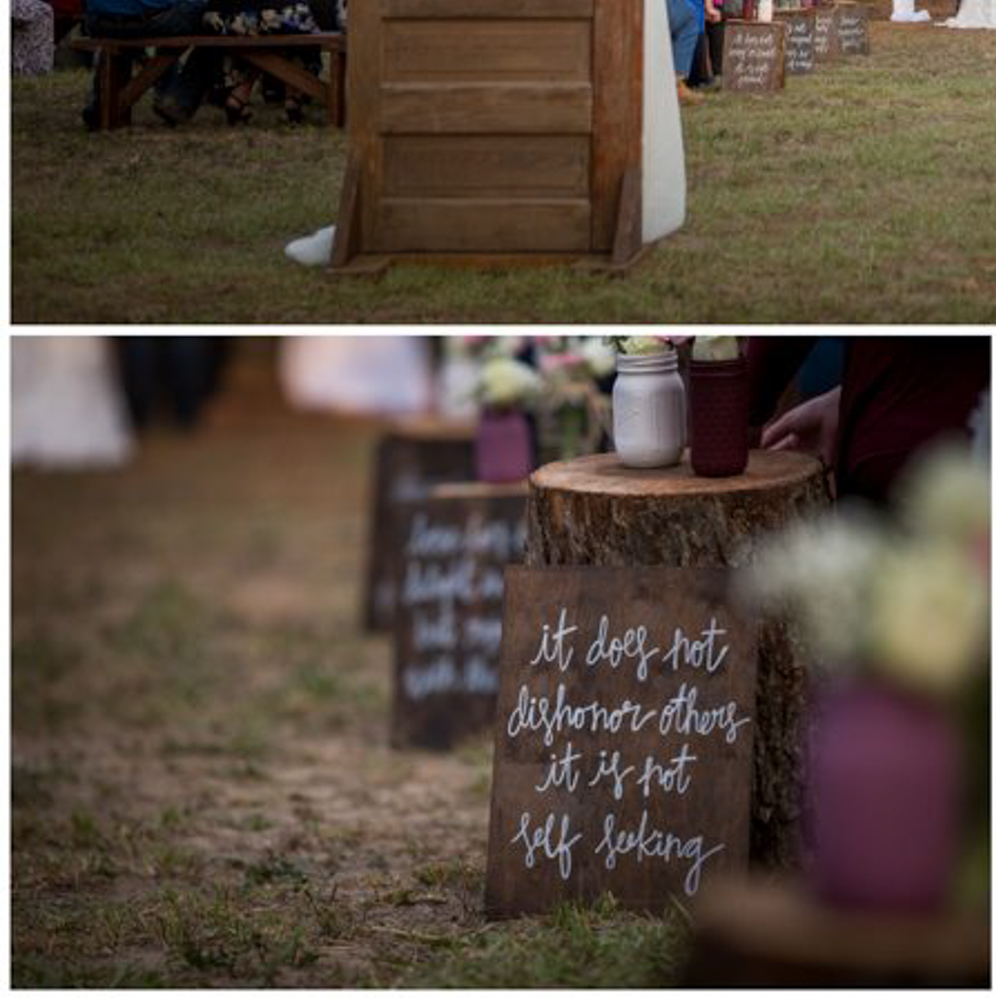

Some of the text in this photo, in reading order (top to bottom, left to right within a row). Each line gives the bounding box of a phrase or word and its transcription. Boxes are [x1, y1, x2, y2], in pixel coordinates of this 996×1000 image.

[530, 608, 578, 672] it
[586, 615, 660, 682] does
[662, 617, 730, 672] not
[508, 683, 751, 746] dishonor others
[536, 742, 697, 800] it is not
[511, 811, 725, 896] self seeking
